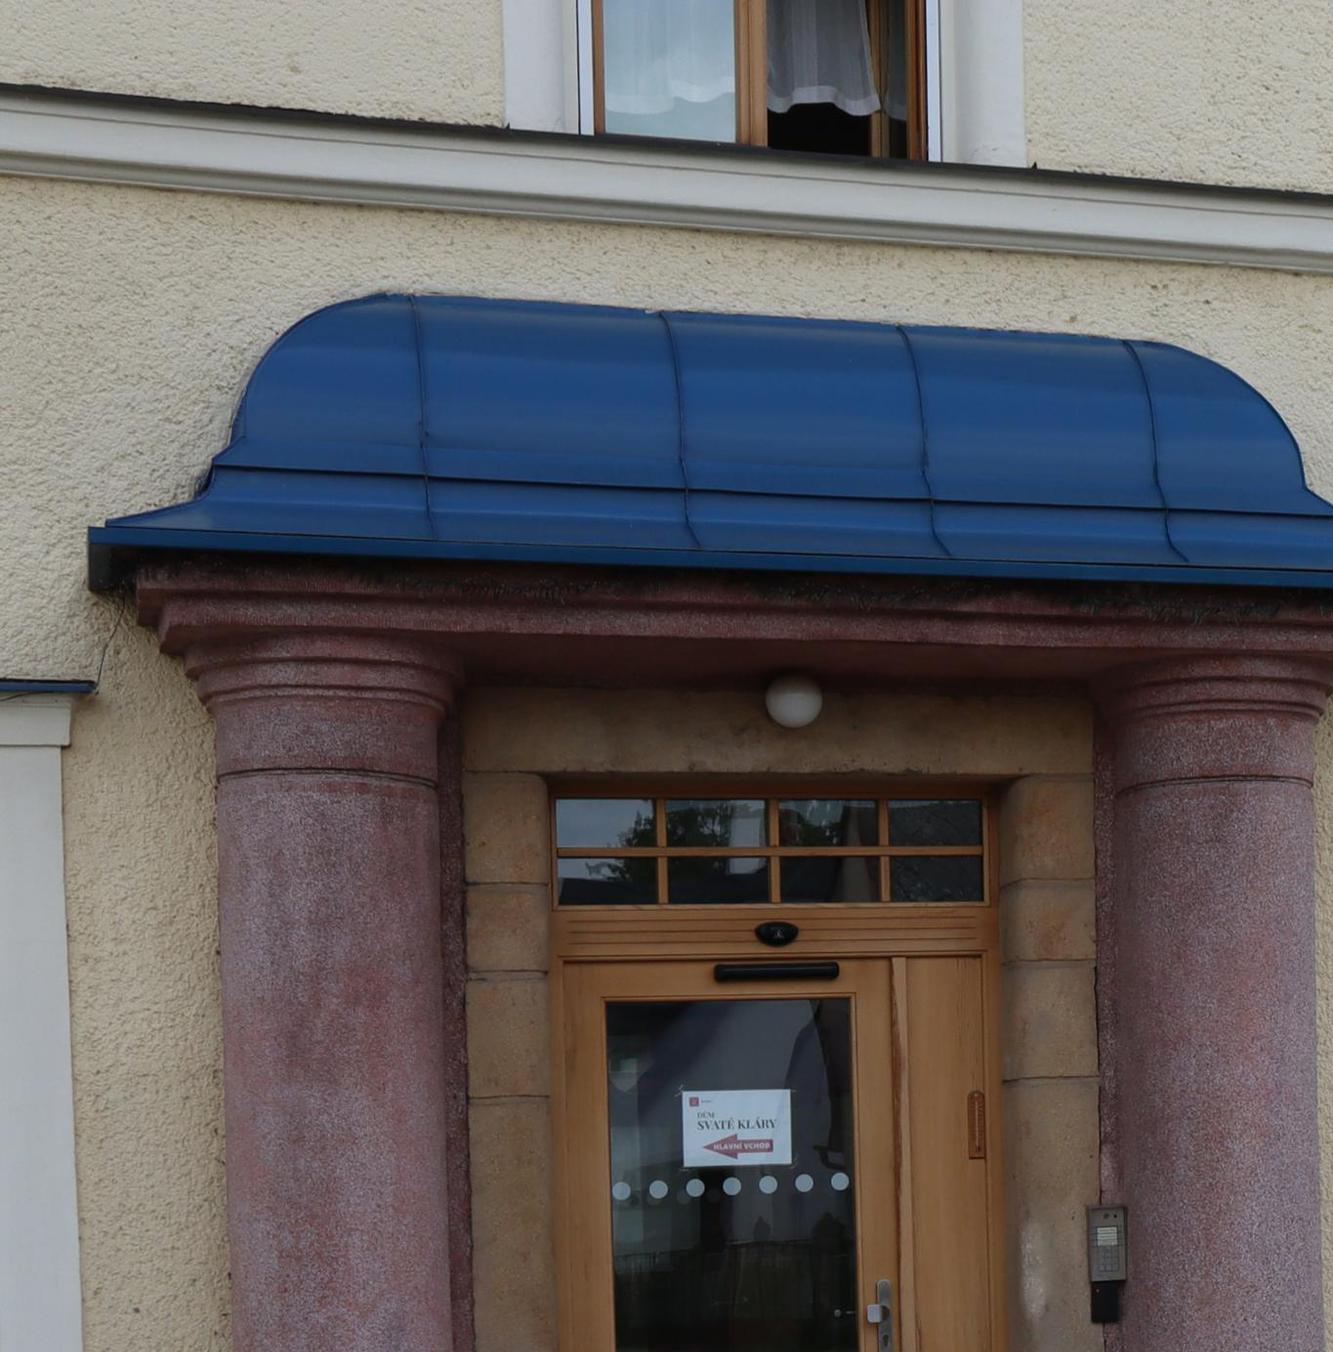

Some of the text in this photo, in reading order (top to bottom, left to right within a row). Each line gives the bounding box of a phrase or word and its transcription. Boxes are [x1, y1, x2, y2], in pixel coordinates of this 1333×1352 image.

[697, 1116, 777, 1131] SVATÉ KLÁRY
[713, 1141, 742, 1151] HLAVNÍ
